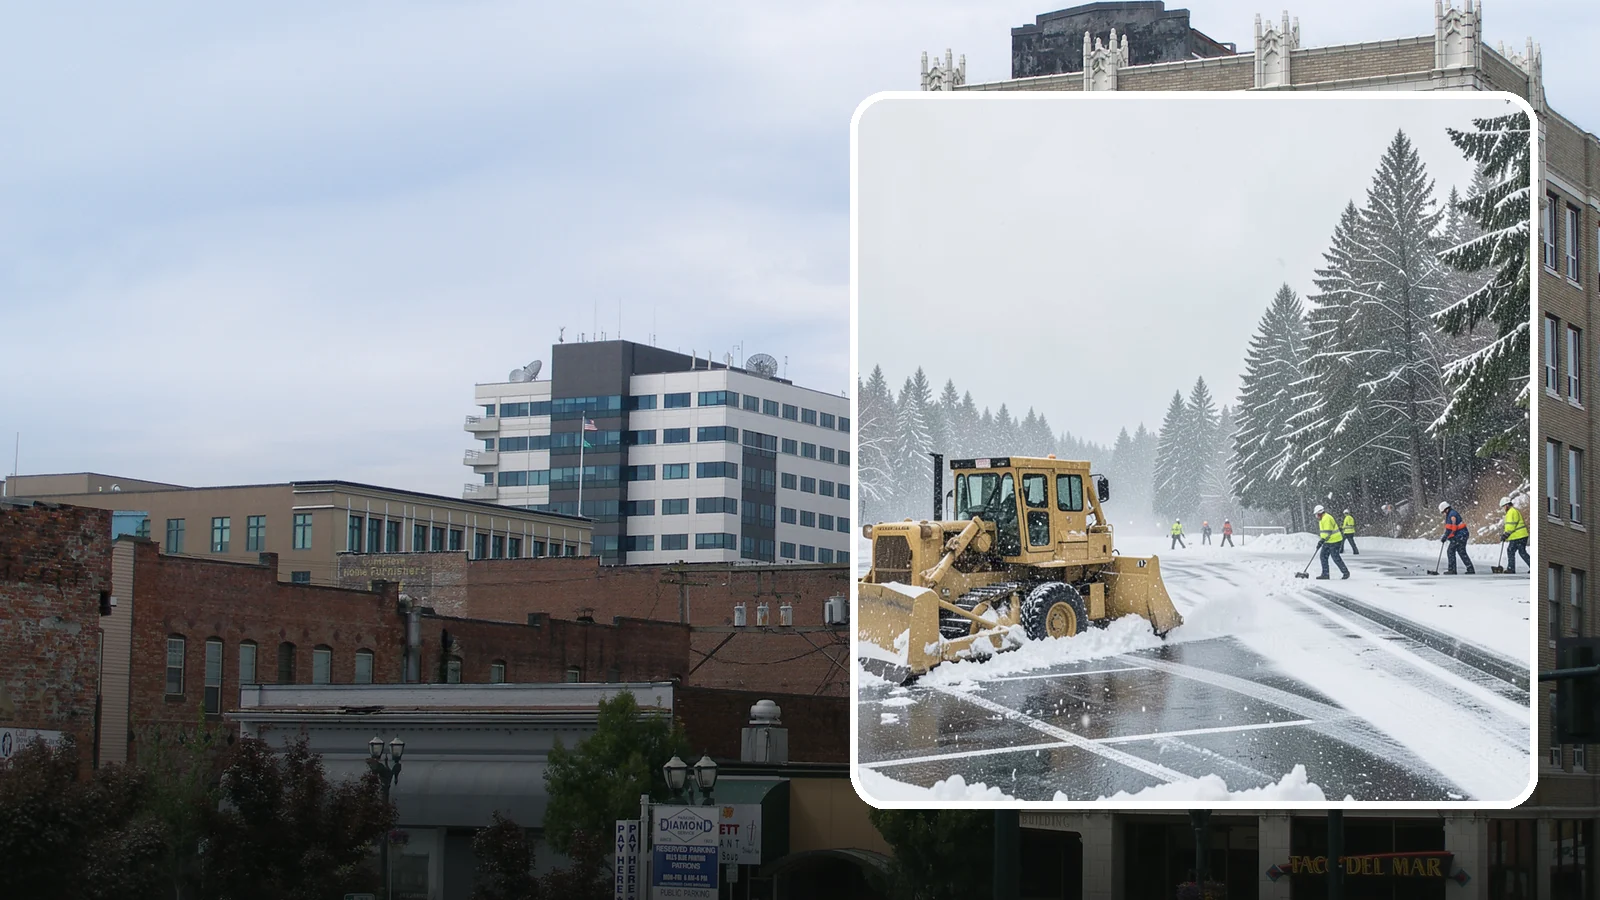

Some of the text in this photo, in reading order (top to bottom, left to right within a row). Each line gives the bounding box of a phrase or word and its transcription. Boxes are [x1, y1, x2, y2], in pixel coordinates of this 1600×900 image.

[660, 818, 713, 833] DIAMOND
[1022, 815, 1070, 828] BUILDING
[656, 845, 716, 854] RESERVED PARKING
[616, 825, 625, 893] PAY HERE
[627, 824, 637, 893] PAY HERE
[671, 862, 701, 870] PATRONS
[1346, 856, 1385, 875] DEL
[1392, 857, 1442, 877] MAR
[660, 888, 710, 899] PUBLIC PARKING
